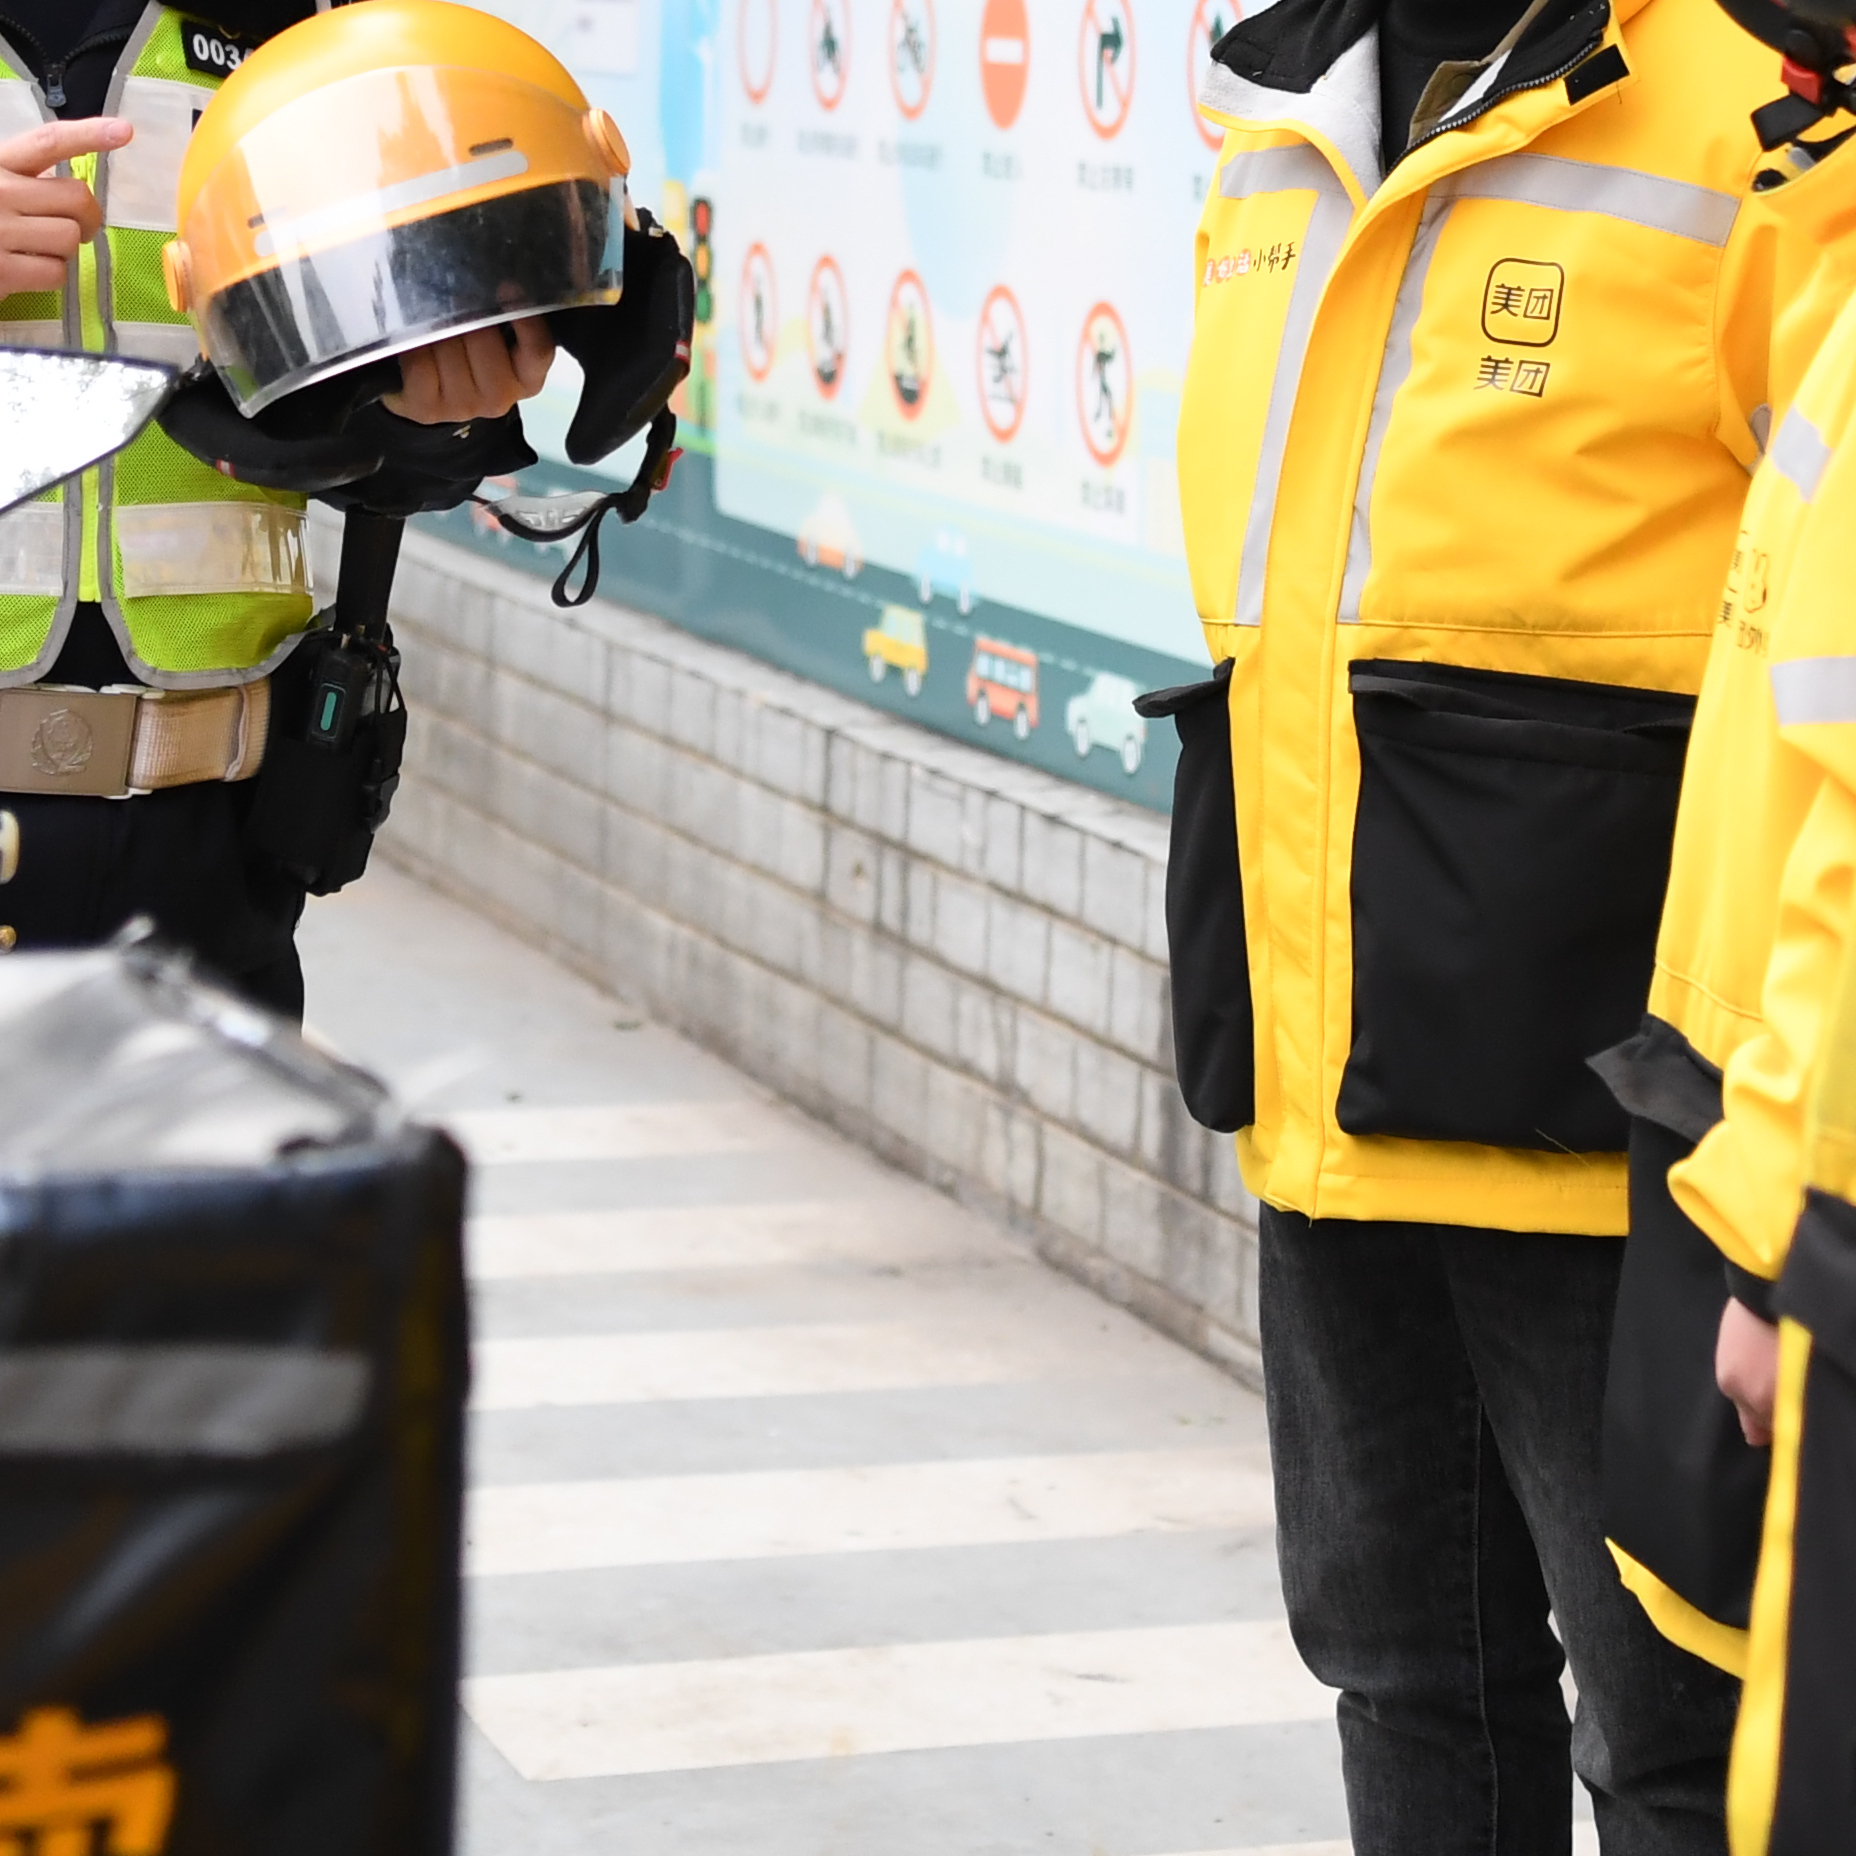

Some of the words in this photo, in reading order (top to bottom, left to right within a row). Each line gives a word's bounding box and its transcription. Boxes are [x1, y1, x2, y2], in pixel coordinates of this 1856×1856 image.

[193, 33, 254, 70] 003
[1490, 283, 1555, 320] 美团
[1473, 355, 1551, 398] 美团
